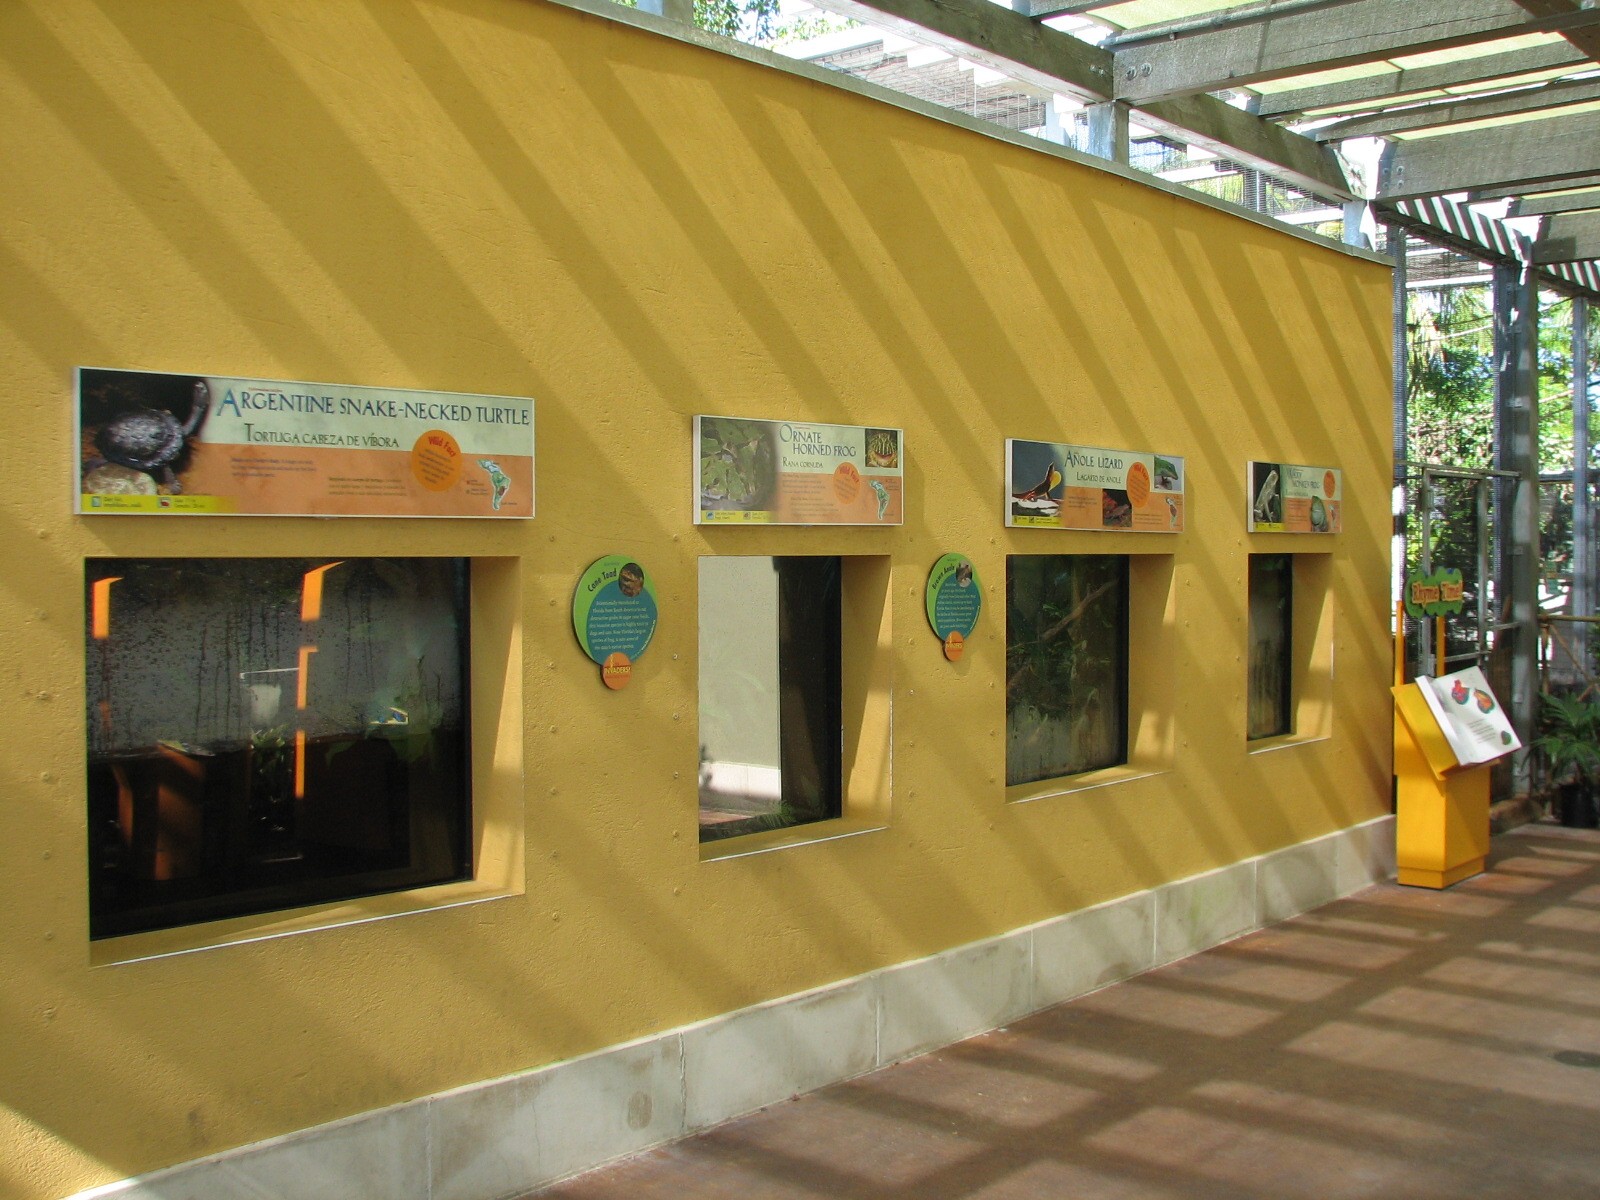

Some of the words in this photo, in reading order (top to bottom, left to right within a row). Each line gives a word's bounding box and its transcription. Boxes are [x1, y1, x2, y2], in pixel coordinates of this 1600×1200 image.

[216, 387, 335, 418] ARGENTINE
[340, 397, 472, 422] SNAKE-NECKED
[475, 406, 530, 426] TURTLE
[244, 422, 300, 444] TORTUGA
[302, 432, 345, 446] CABEZA
[346, 435, 360, 446] DE
[779, 423, 822, 444] ORNATE
[428, 436, 444, 447] Wild
[443, 441, 457, 458] Fact
[792, 443, 832, 456] HORNED
[833, 445, 857, 458] FROG
[782, 456, 800, 468] RANA
[1097, 457, 1124, 470] LIZARD
[587, 578, 602, 592] Cane
[601, 568, 617, 580] Toad
[1412, 581, 1440, 608] Rhyme
